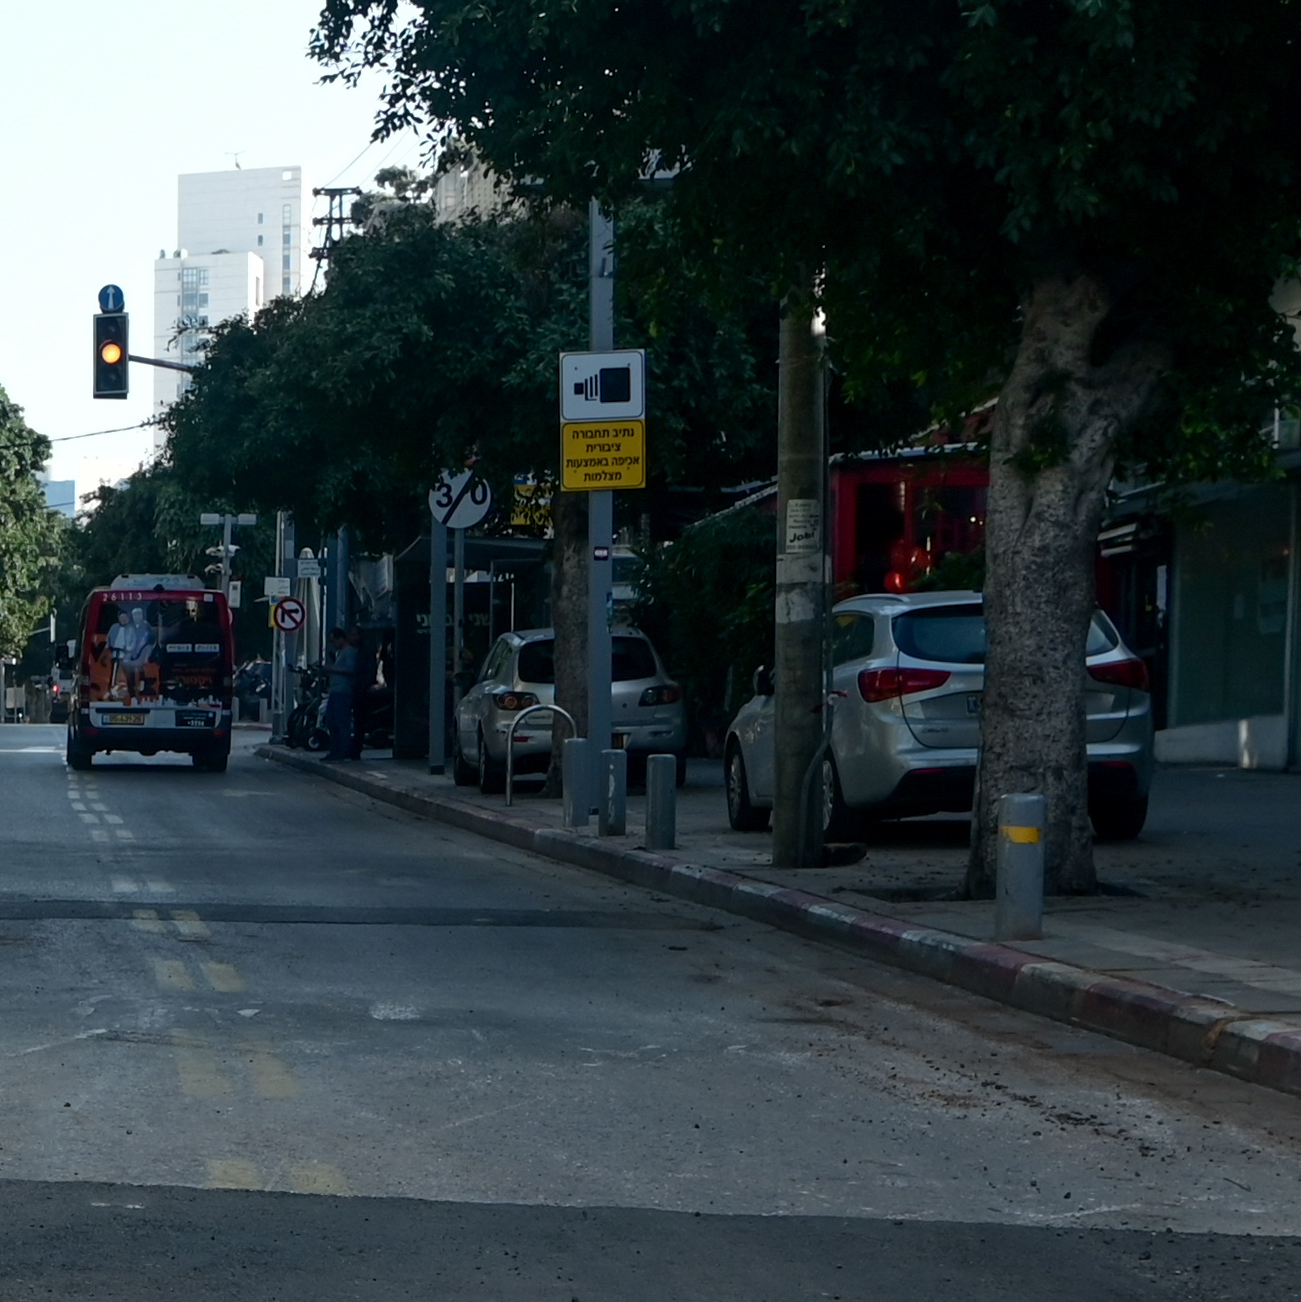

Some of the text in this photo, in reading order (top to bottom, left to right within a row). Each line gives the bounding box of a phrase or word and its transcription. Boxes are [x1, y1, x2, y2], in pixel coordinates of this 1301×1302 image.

[571, 428, 635, 440] נתיב תחבורה
[585, 442, 622, 453] ציבורית
[565, 456, 640, 469] אכיפה באמצעות
[583, 470, 622, 482] מצלמות
[435, 482, 488, 508] 30
[102, 592, 142, 602] 26113
